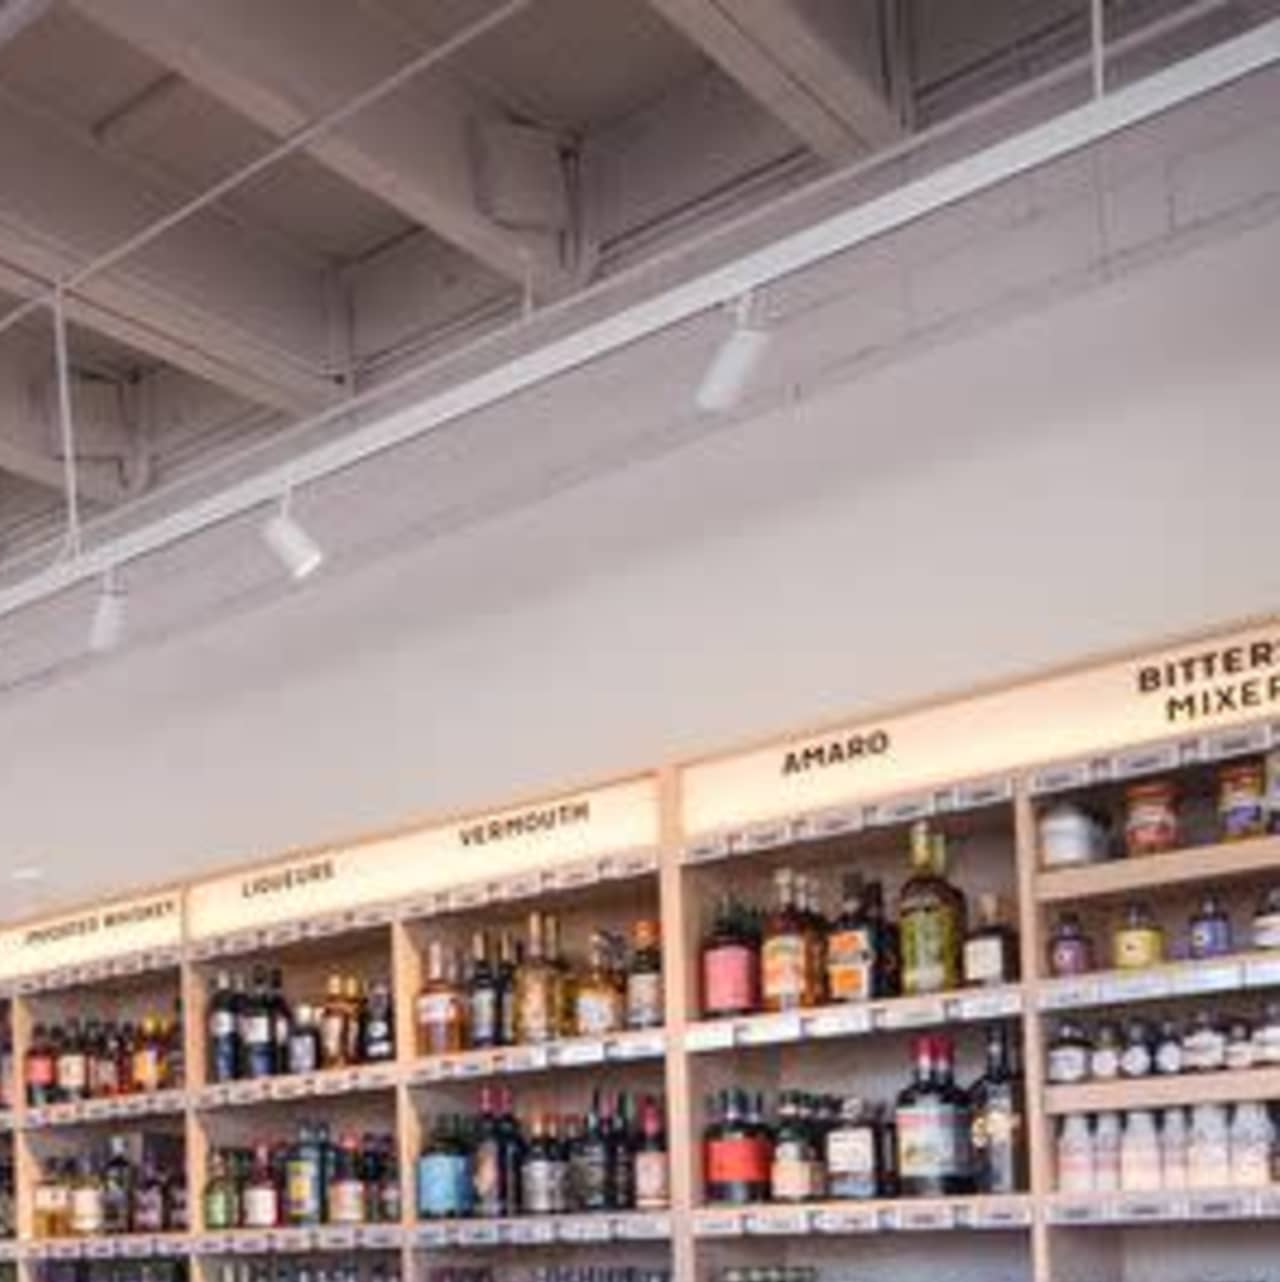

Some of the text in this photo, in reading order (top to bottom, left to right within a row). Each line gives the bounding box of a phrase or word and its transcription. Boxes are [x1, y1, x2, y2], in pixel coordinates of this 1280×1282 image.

[1140, 641, 1280, 694] BITTER
[782, 730, 889, 776] AMARO
[459, 801, 590, 847] VERMOUTH
